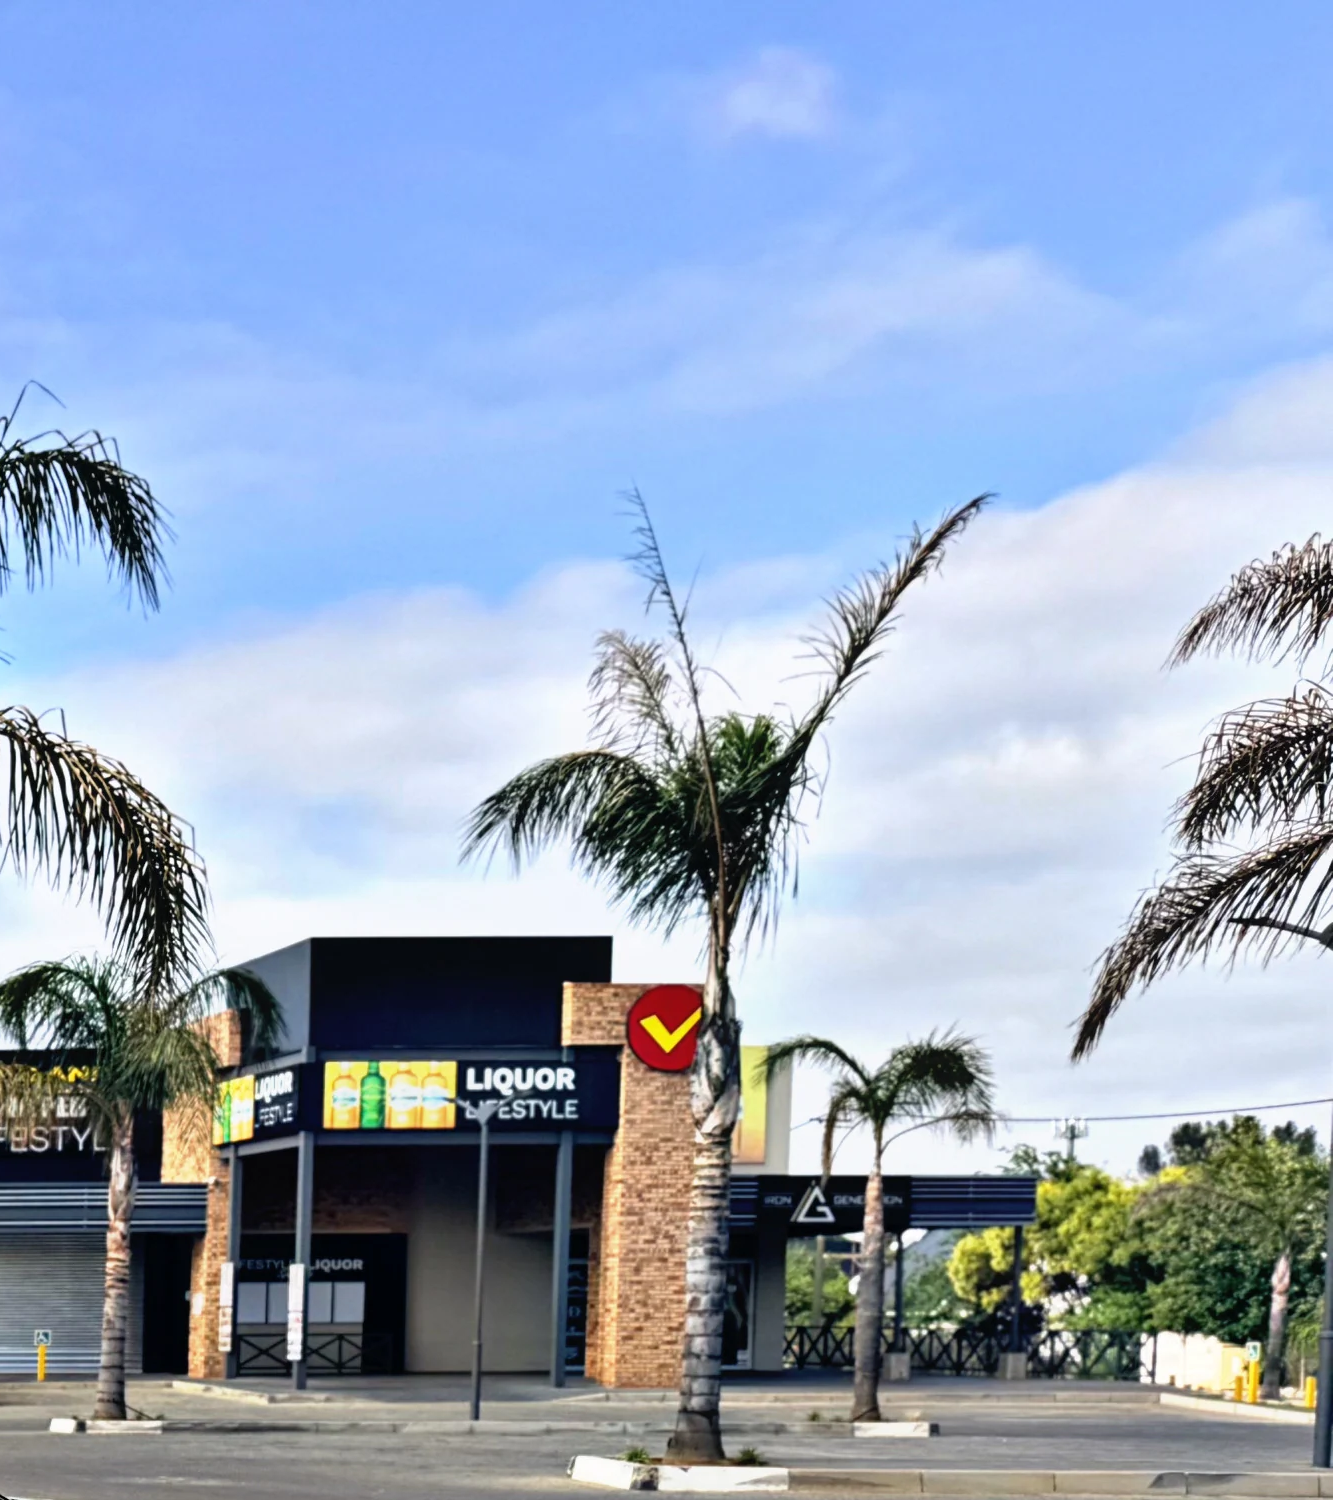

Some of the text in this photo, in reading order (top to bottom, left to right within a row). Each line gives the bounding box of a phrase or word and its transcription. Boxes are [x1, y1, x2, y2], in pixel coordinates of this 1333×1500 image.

[254, 1071, 293, 1104] LIQUOR
[465, 1066, 577, 1096] LIQUOR
[464, 1099, 579, 1119] LESTYLE
